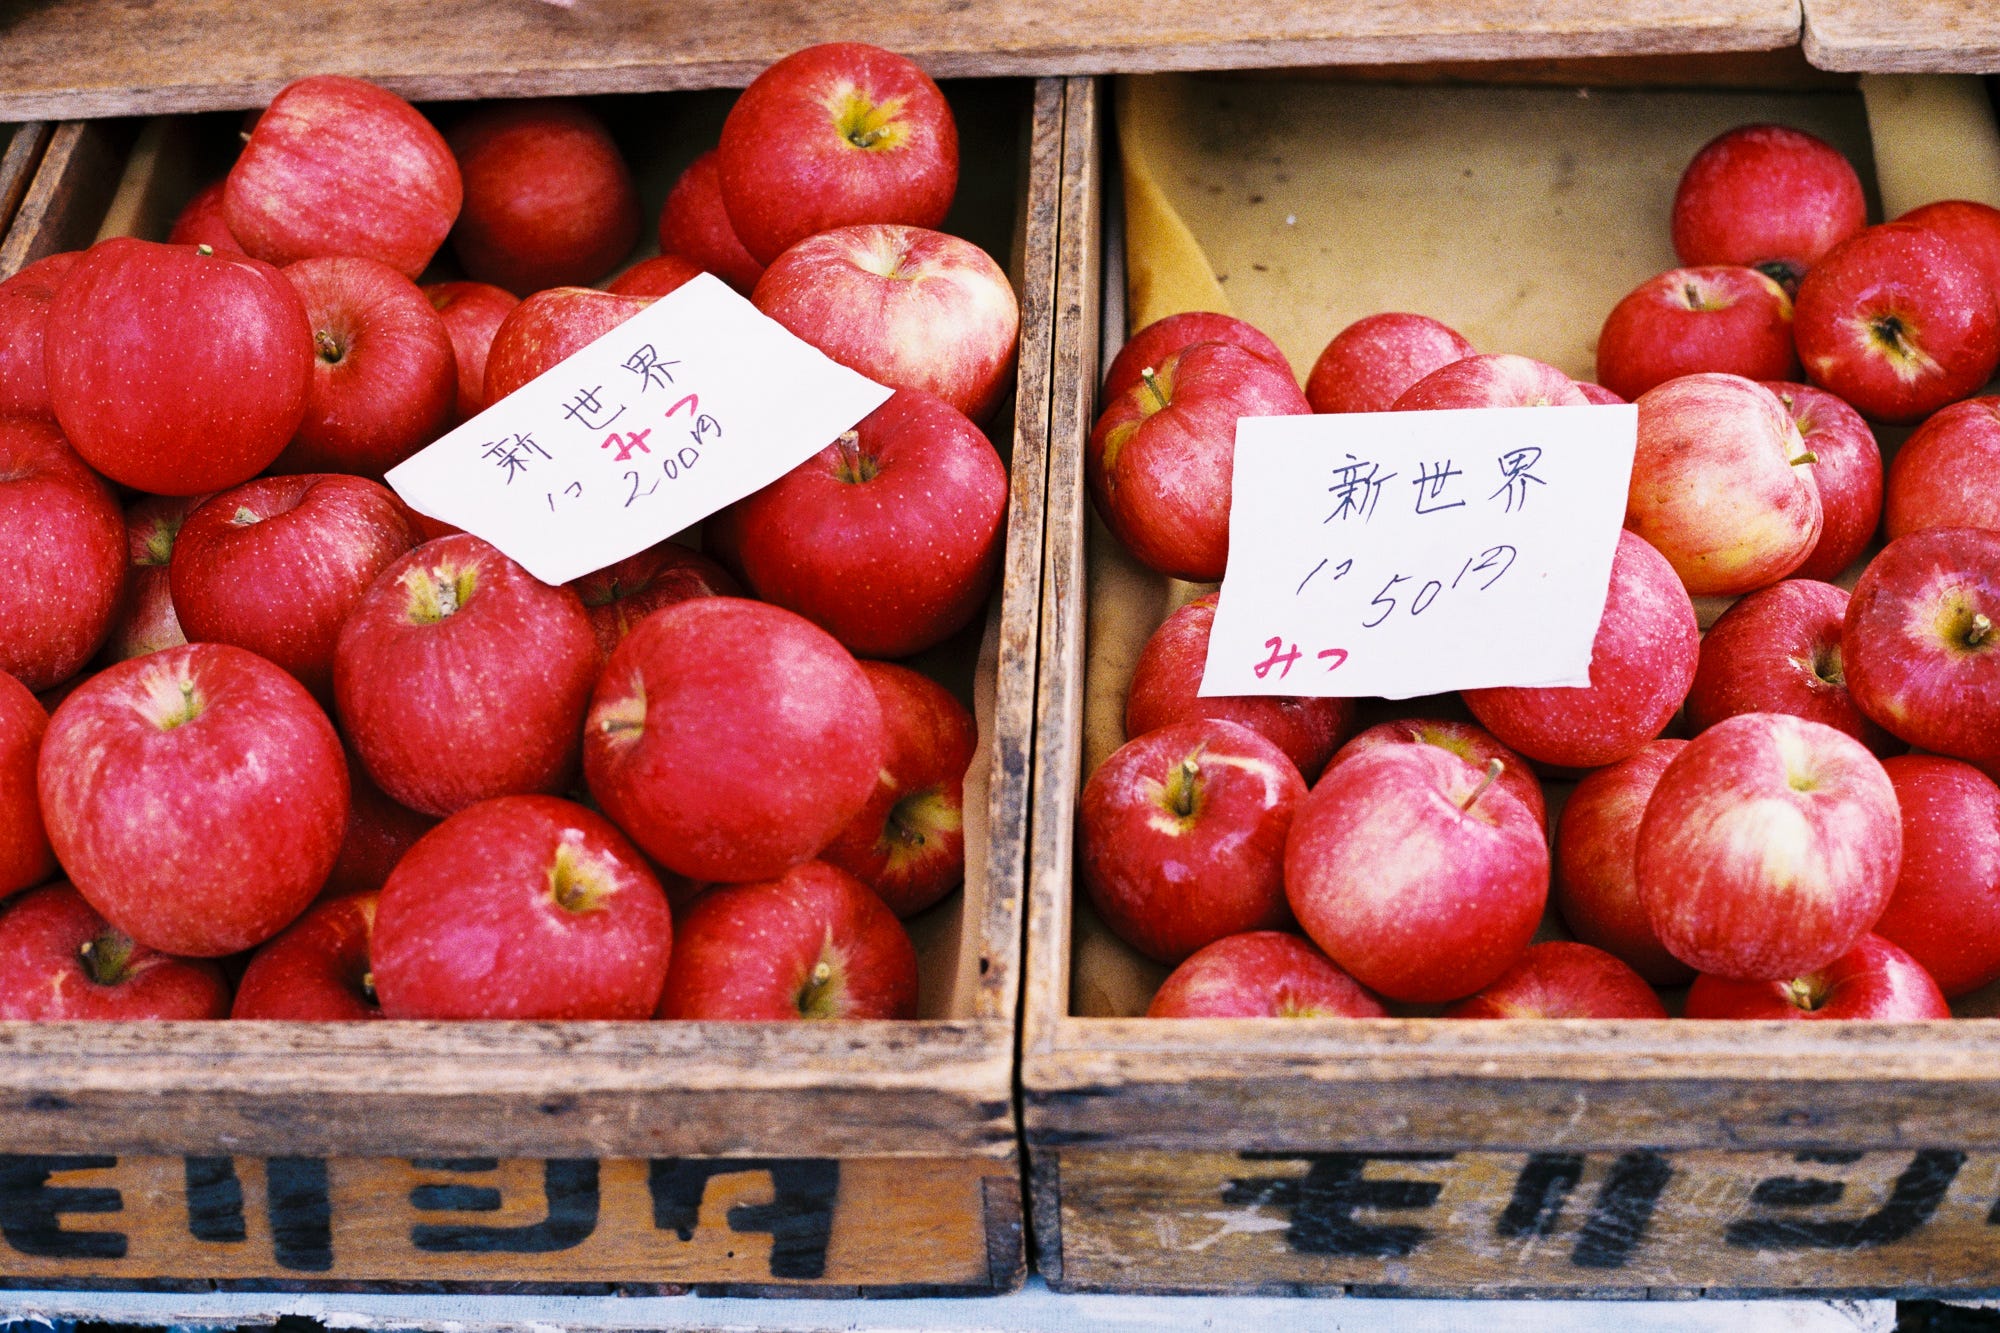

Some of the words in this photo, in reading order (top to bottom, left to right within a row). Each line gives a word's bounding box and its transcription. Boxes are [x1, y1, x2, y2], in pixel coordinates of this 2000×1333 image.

[480, 343, 681, 485] 新世界
[601, 393, 699, 462] みつ
[623, 414, 722, 508] 200円
[1323, 446, 1548, 525] 新世界
[1361, 544, 1518, 629] 50円
[1252, 635, 1349, 680] みつ
